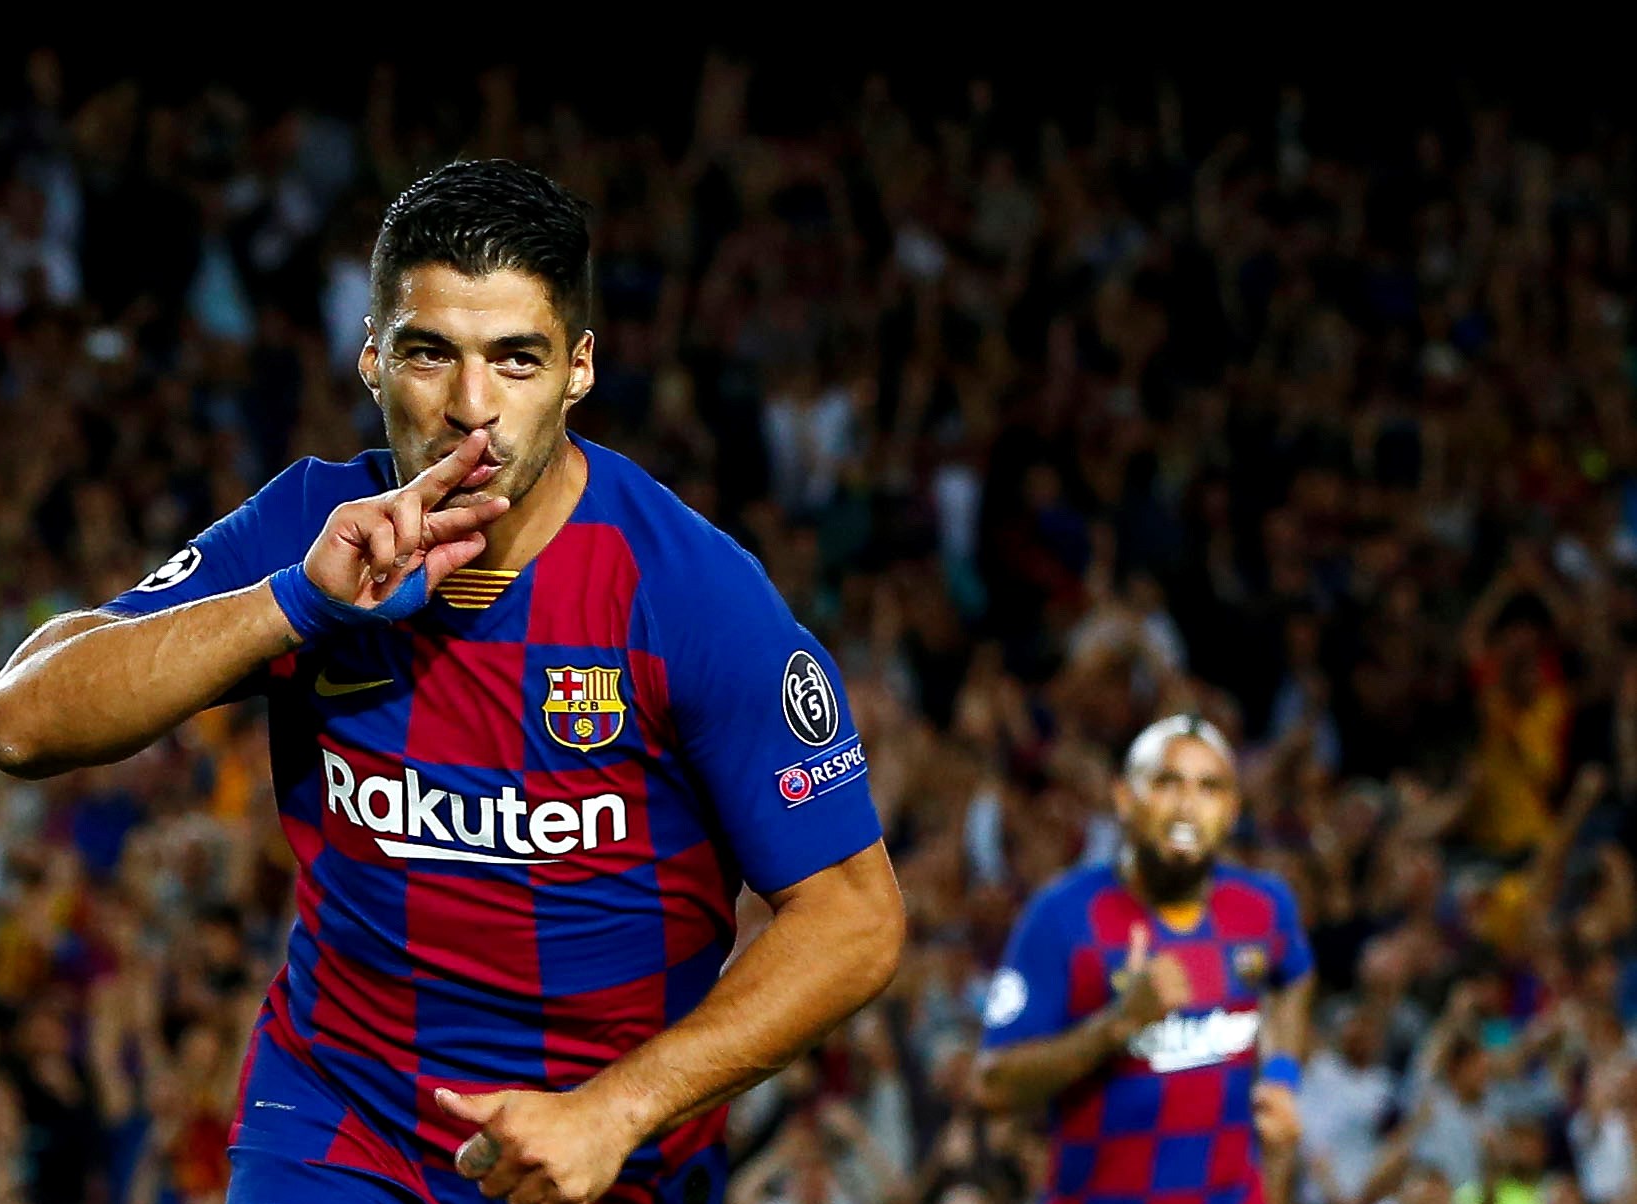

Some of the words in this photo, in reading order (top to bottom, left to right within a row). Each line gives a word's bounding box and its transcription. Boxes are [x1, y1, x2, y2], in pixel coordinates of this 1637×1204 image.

[567, 701, 599, 712] FCB
[808, 695, 822, 721] 5
[322, 748, 627, 856] Rakuten
